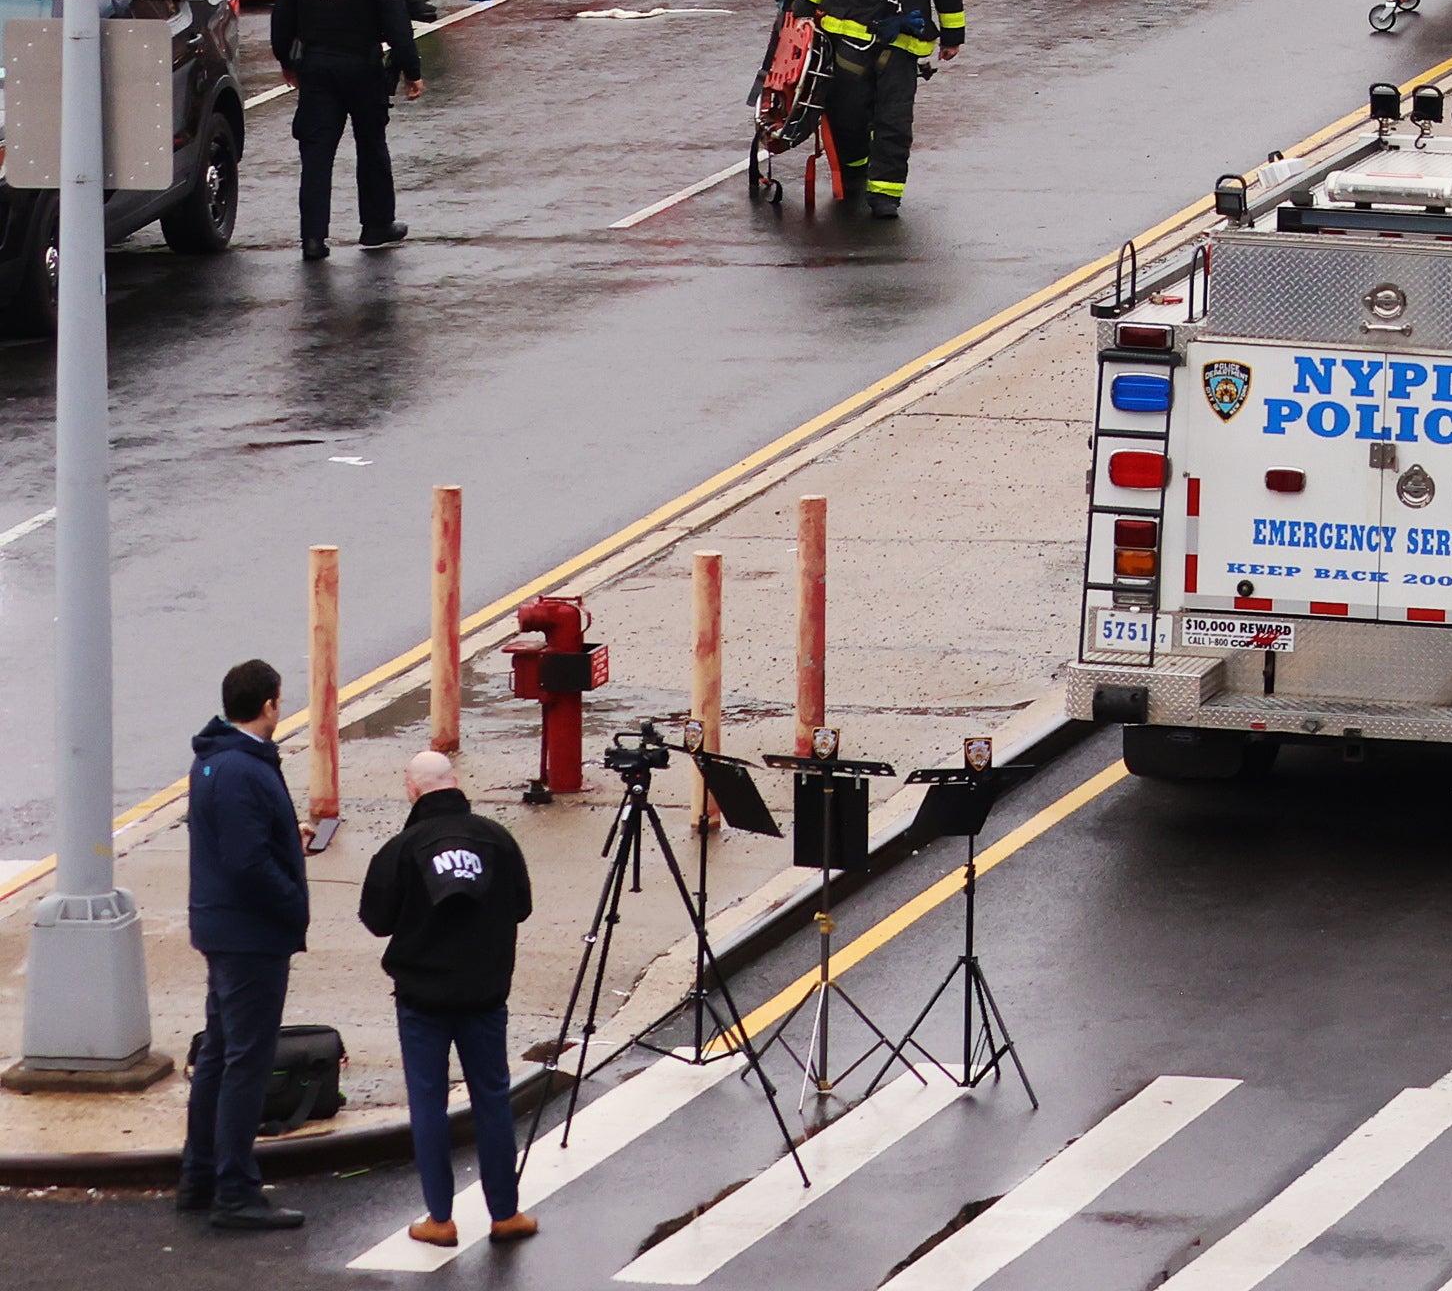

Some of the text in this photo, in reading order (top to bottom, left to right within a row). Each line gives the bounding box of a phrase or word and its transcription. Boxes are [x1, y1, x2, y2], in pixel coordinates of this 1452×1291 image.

[1252, 517, 1397, 554] EMERGENCY
[1227, 562, 1302, 579] KEEP
[1314, 567, 1389, 583] BACK
[1103, 619, 1167, 644] 5751 7
[431, 849, 483, 876] NYPD
